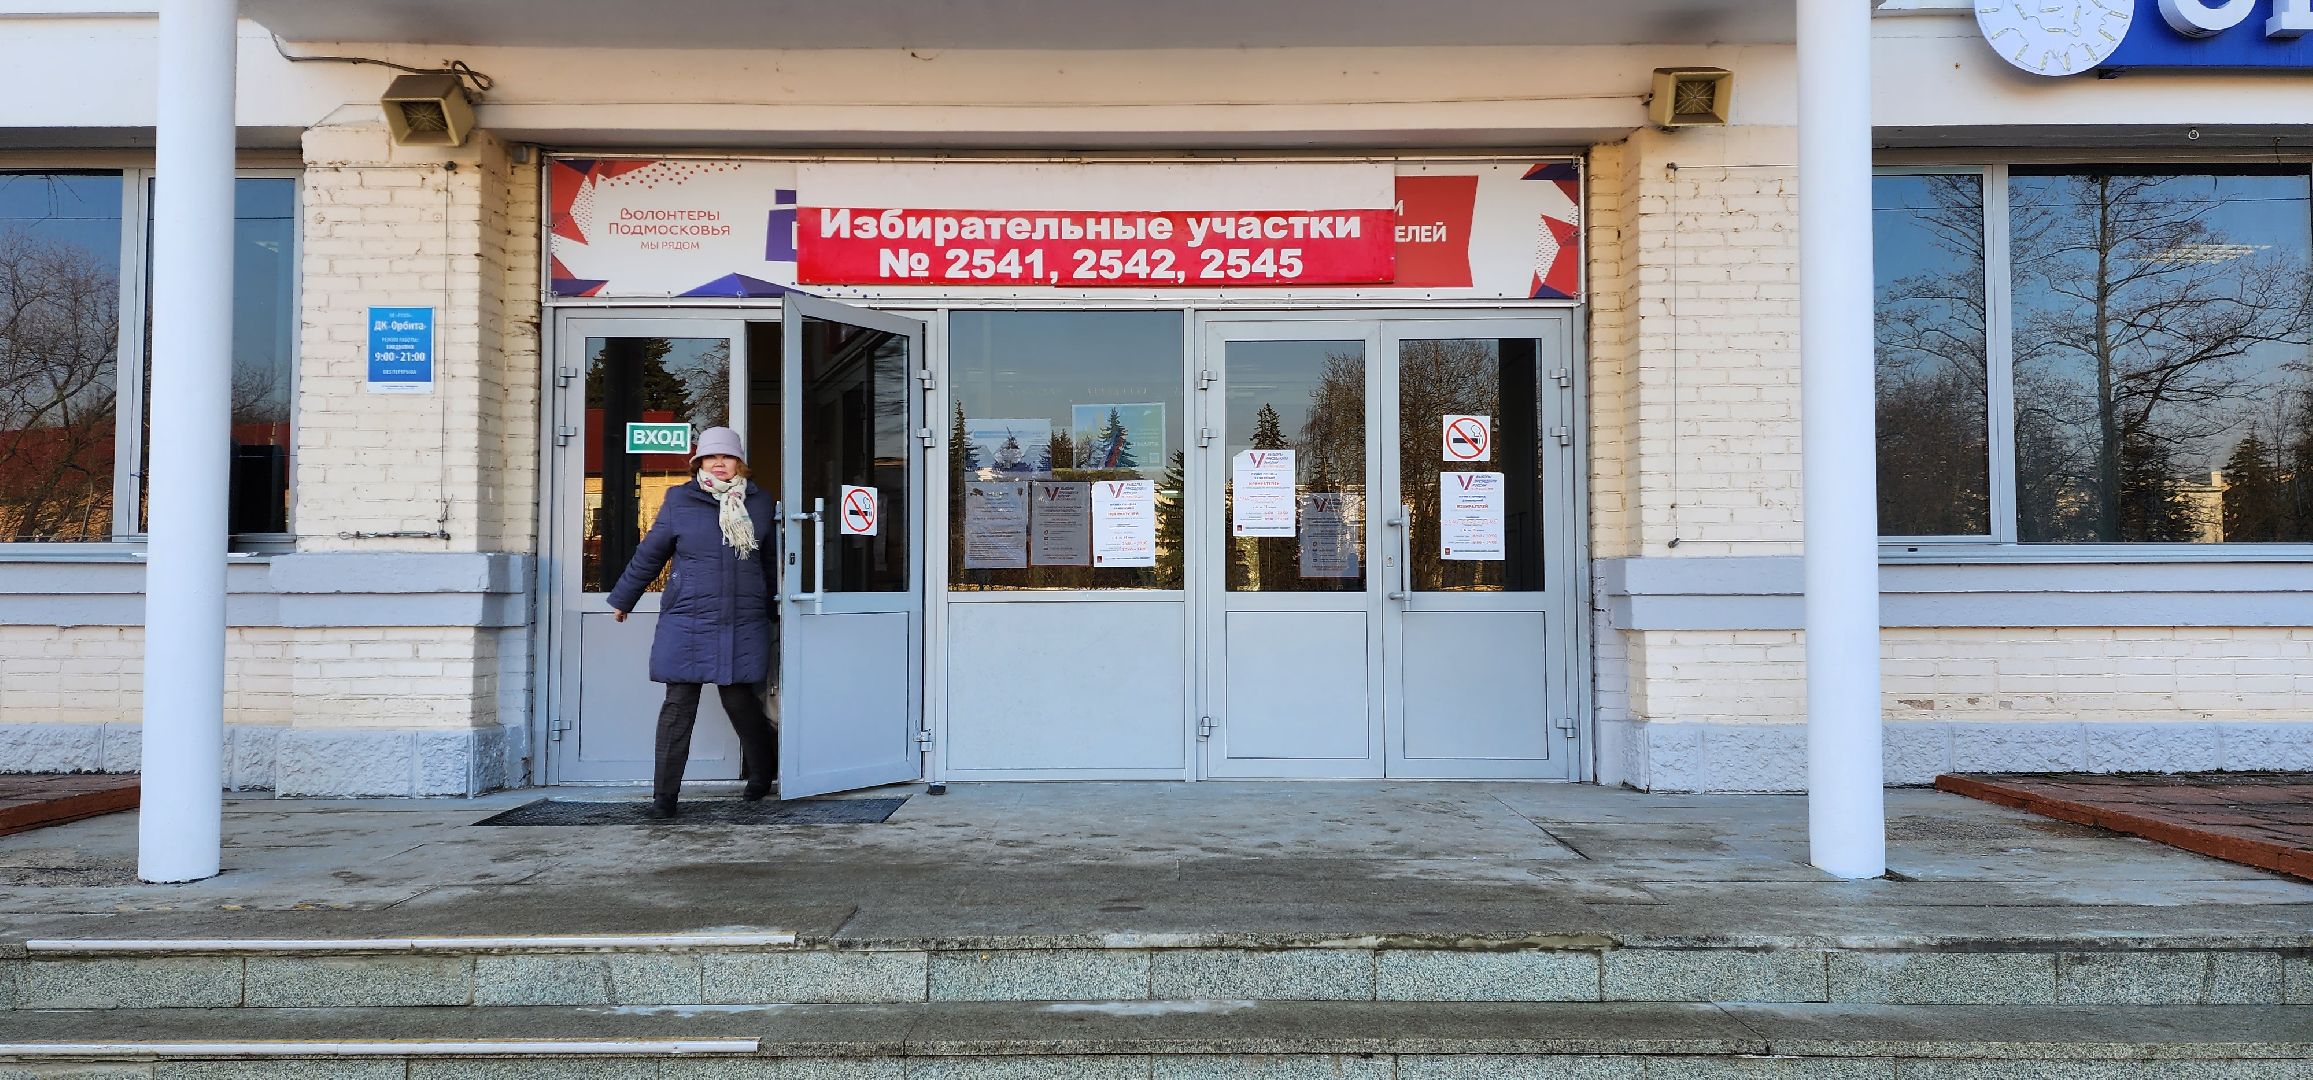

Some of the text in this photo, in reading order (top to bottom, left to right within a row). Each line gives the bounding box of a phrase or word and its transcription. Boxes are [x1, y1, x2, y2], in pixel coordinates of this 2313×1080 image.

[820, 208, 1361, 248] Избирательные участки
[640, 241, 700, 251] МЫ РЯДОМ
[879, 248, 1304, 285] № 2541, 2542, 2545
[374, 320, 388, 331] ДК
[374, 351, 395, 362] 9:00
[400, 351, 426, 362] 21:00
[633, 429, 686, 448] ВХОД
